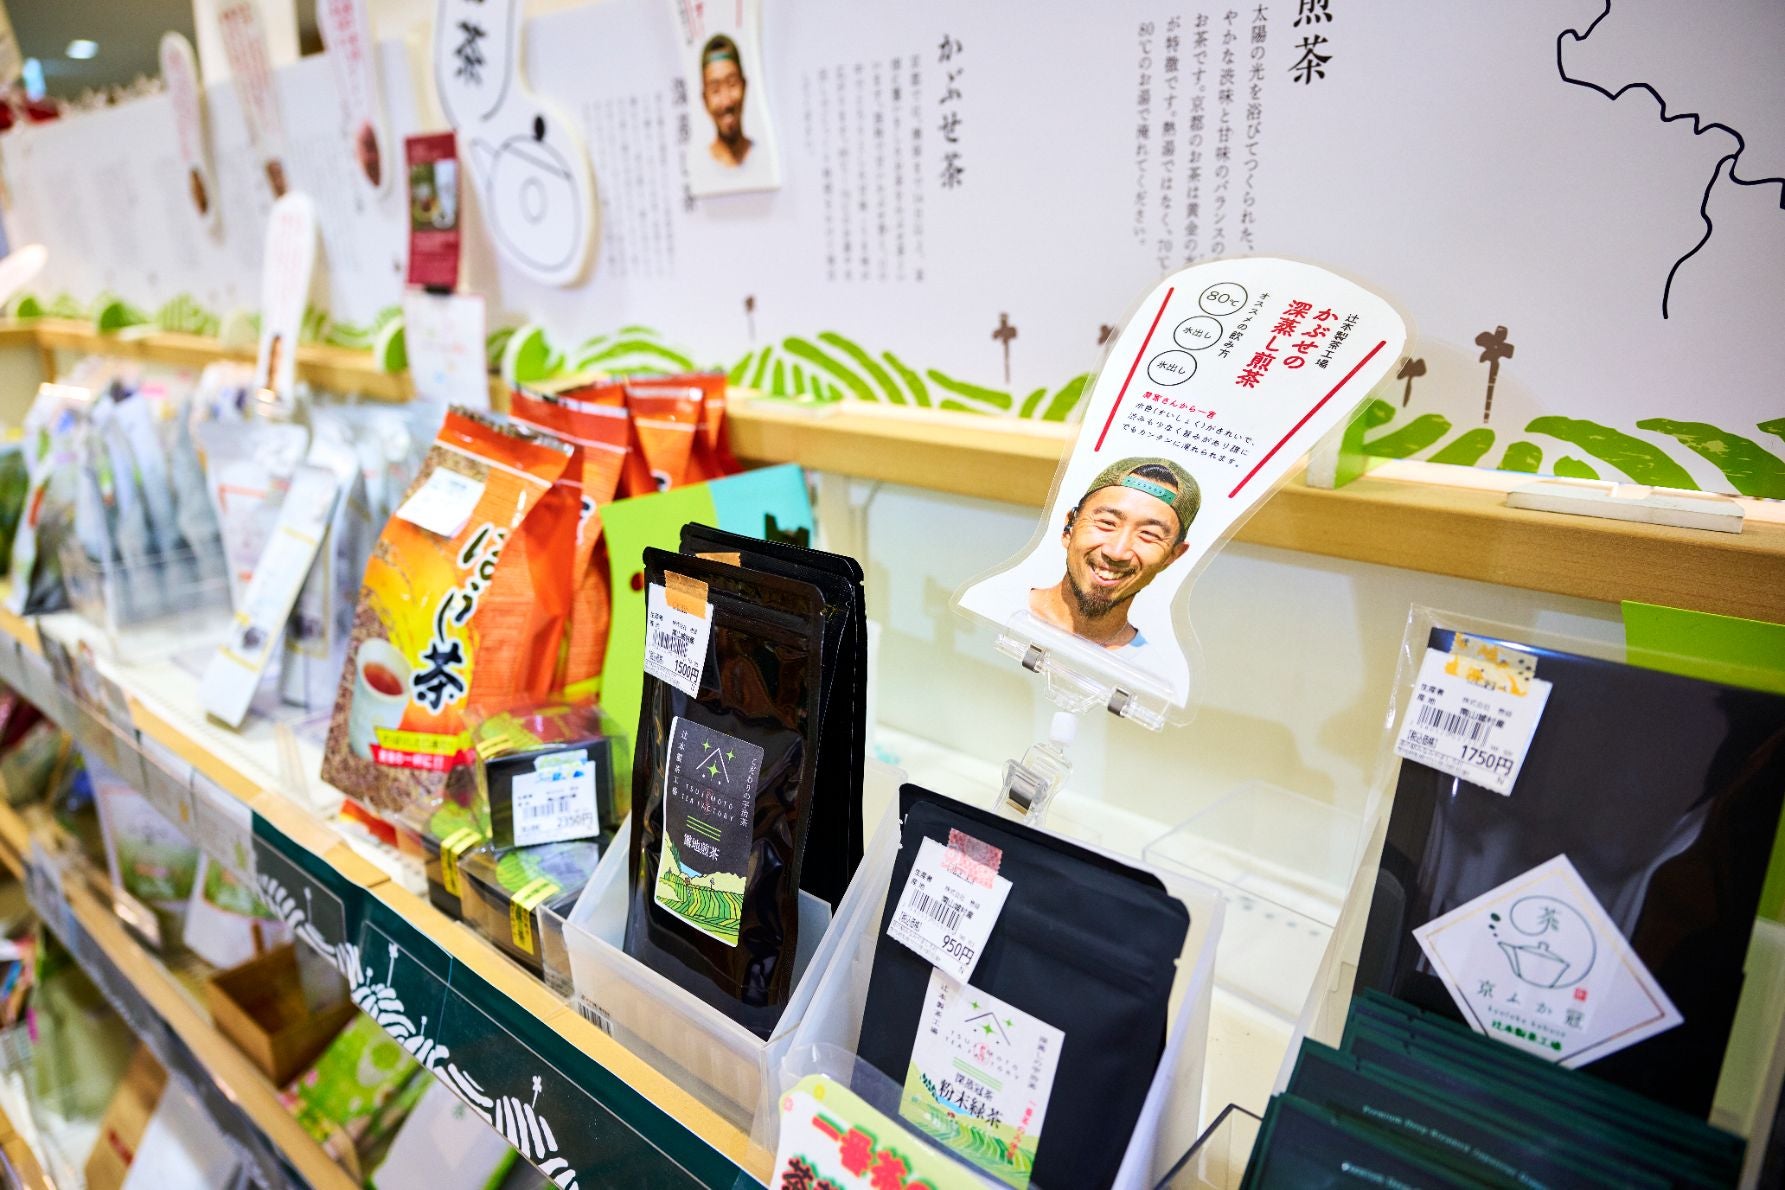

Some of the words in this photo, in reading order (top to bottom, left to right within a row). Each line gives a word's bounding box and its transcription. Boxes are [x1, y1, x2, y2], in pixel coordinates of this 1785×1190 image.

[938, 33, 965, 190] かぶせ茶
[1183, 326, 1212, 339] 水出し
[1217, 292, 1270, 359] オススメの飲み方
[1235, 299, 1313, 389] 深蒸し煎茶
[1283, 308, 1339, 369] かぶせの
[1315, 313, 1360, 369] 辻本製茶工場
[674, 659, 700, 684] 1500円
[1460, 744, 1514, 777] 1750円
[1537, 906, 1562, 931] 茶
[942, 935, 975, 965] 950円
[939, 1079, 1004, 1129] 粉末緑茶
